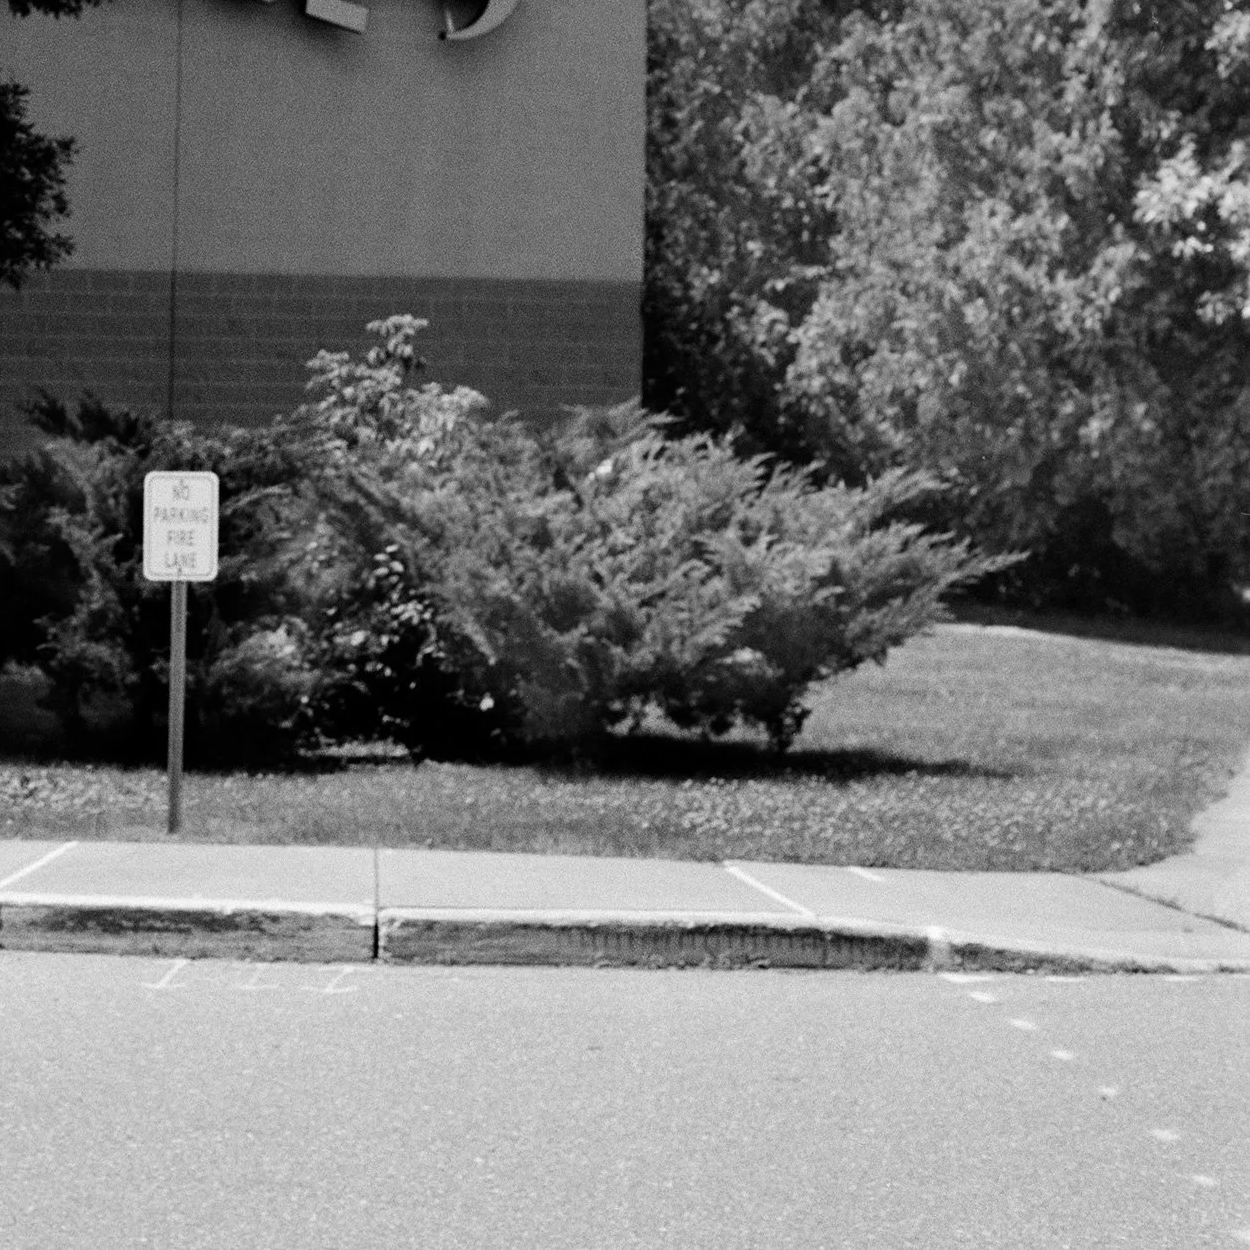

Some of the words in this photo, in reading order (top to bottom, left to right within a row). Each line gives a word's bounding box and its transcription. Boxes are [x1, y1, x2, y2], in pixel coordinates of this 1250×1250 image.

[172, 484, 190, 501] NO
[153, 506, 209, 524] PARKING
[167, 529, 195, 546] FIRE
[165, 552, 197, 569] LANE
